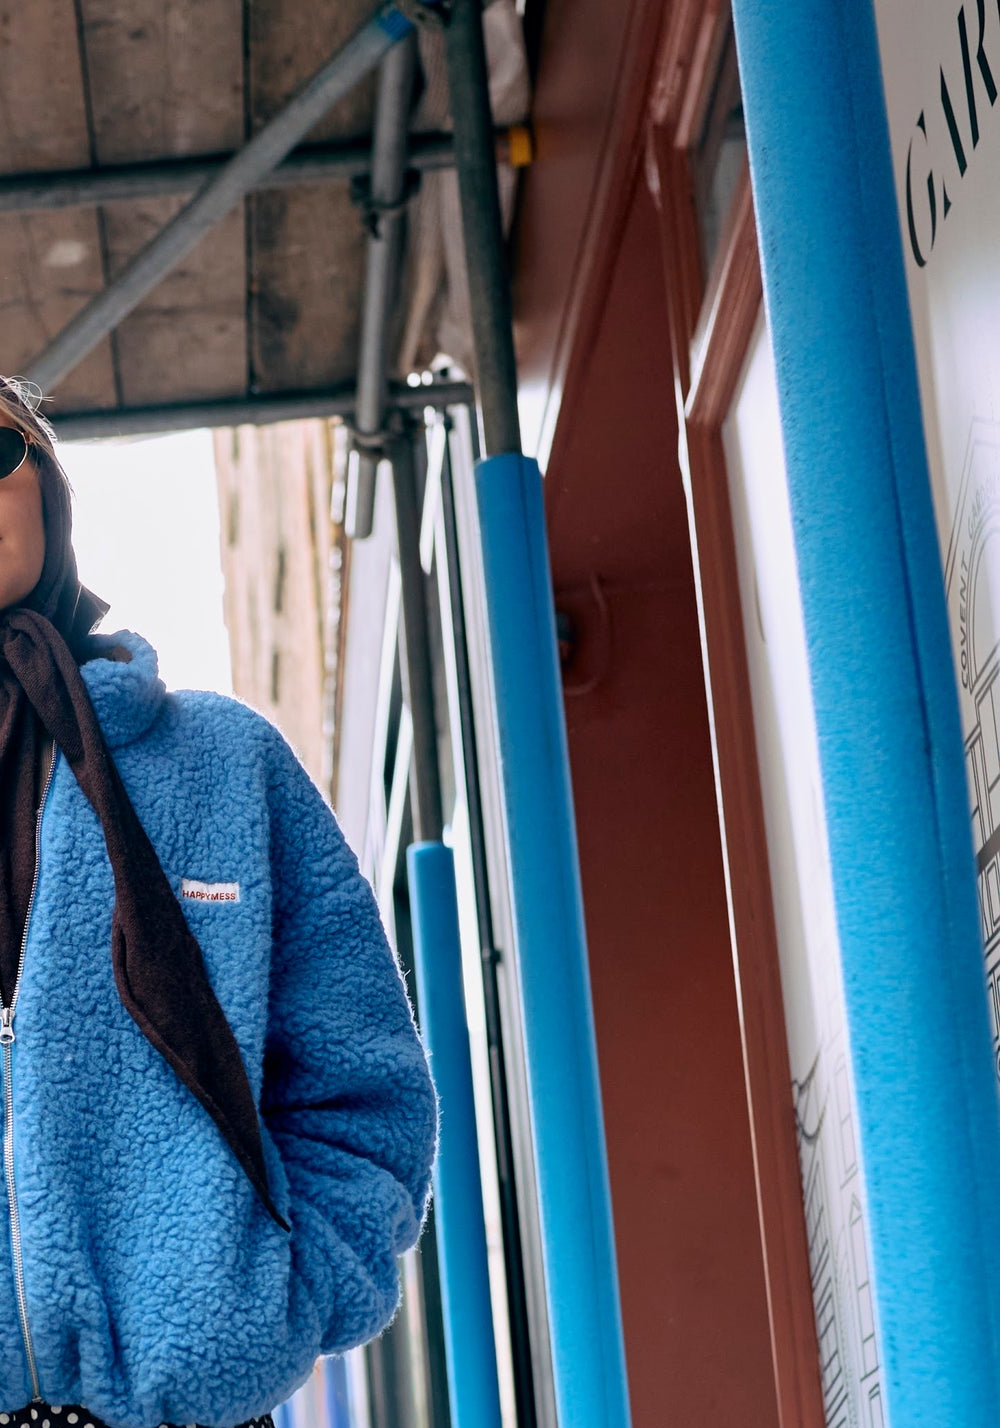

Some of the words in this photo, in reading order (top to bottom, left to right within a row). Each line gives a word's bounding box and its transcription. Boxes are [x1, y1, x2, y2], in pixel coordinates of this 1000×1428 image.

[906, 0, 1000, 267] GAR
[959, 550, 969, 690] COVENT
[182, 889, 237, 901] HAPPYMESS
